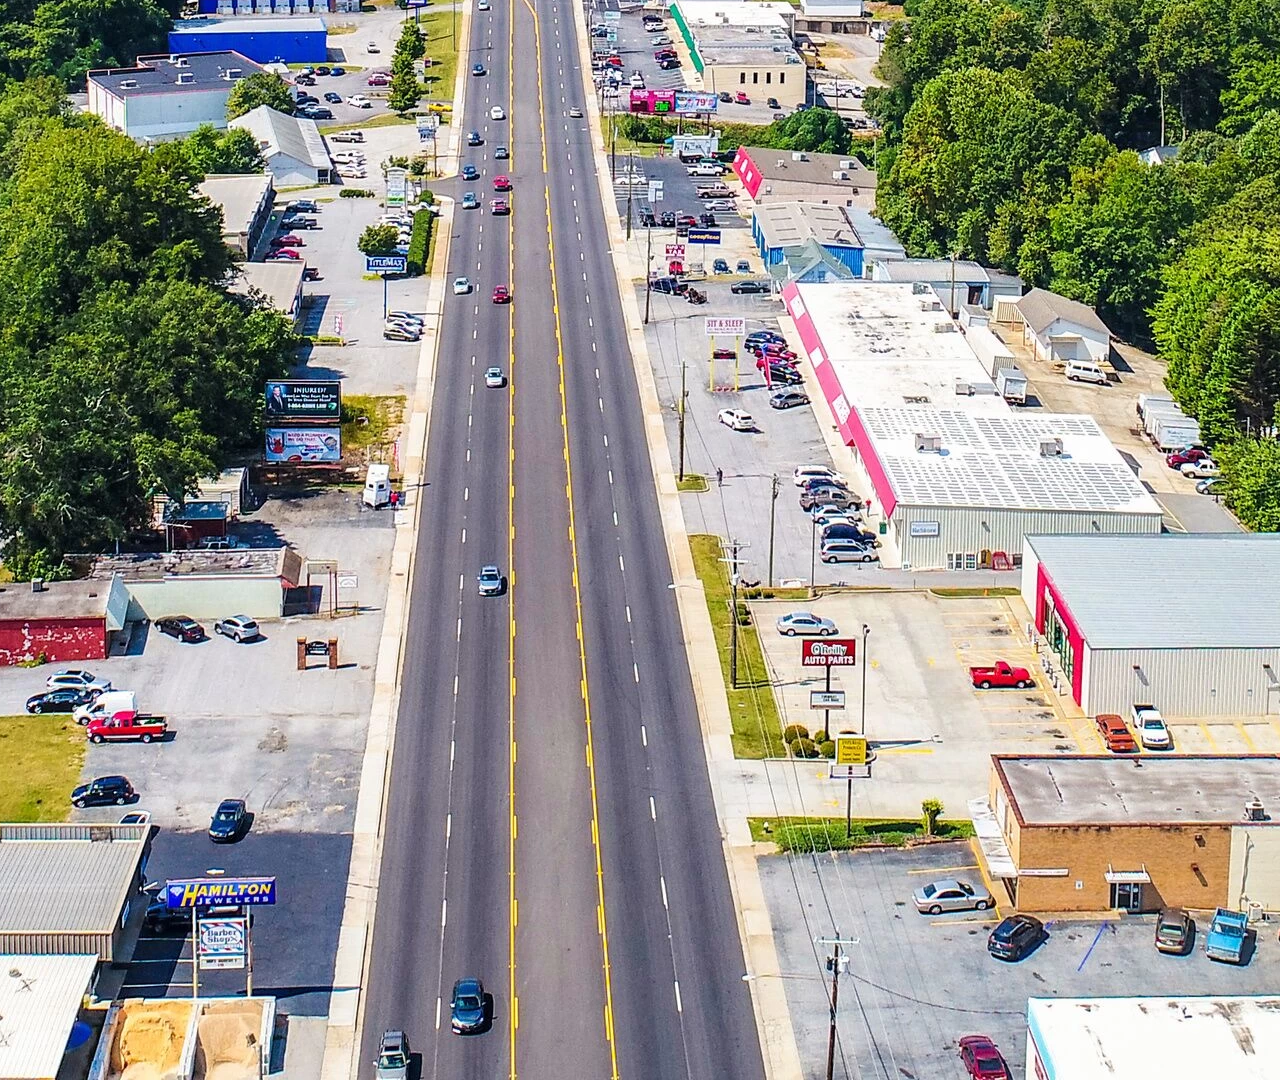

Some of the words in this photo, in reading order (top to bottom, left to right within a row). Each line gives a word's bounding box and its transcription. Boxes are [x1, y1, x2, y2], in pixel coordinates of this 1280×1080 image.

[811, 642, 848, 656] O'Reilly
[804, 656, 826, 664] AUTO
[828, 656, 854, 664] PARTS
[180, 883, 272, 907] HAMILTON
[196, 896, 269, 905] JEWELERS
[207, 936, 231, 944] Shop
